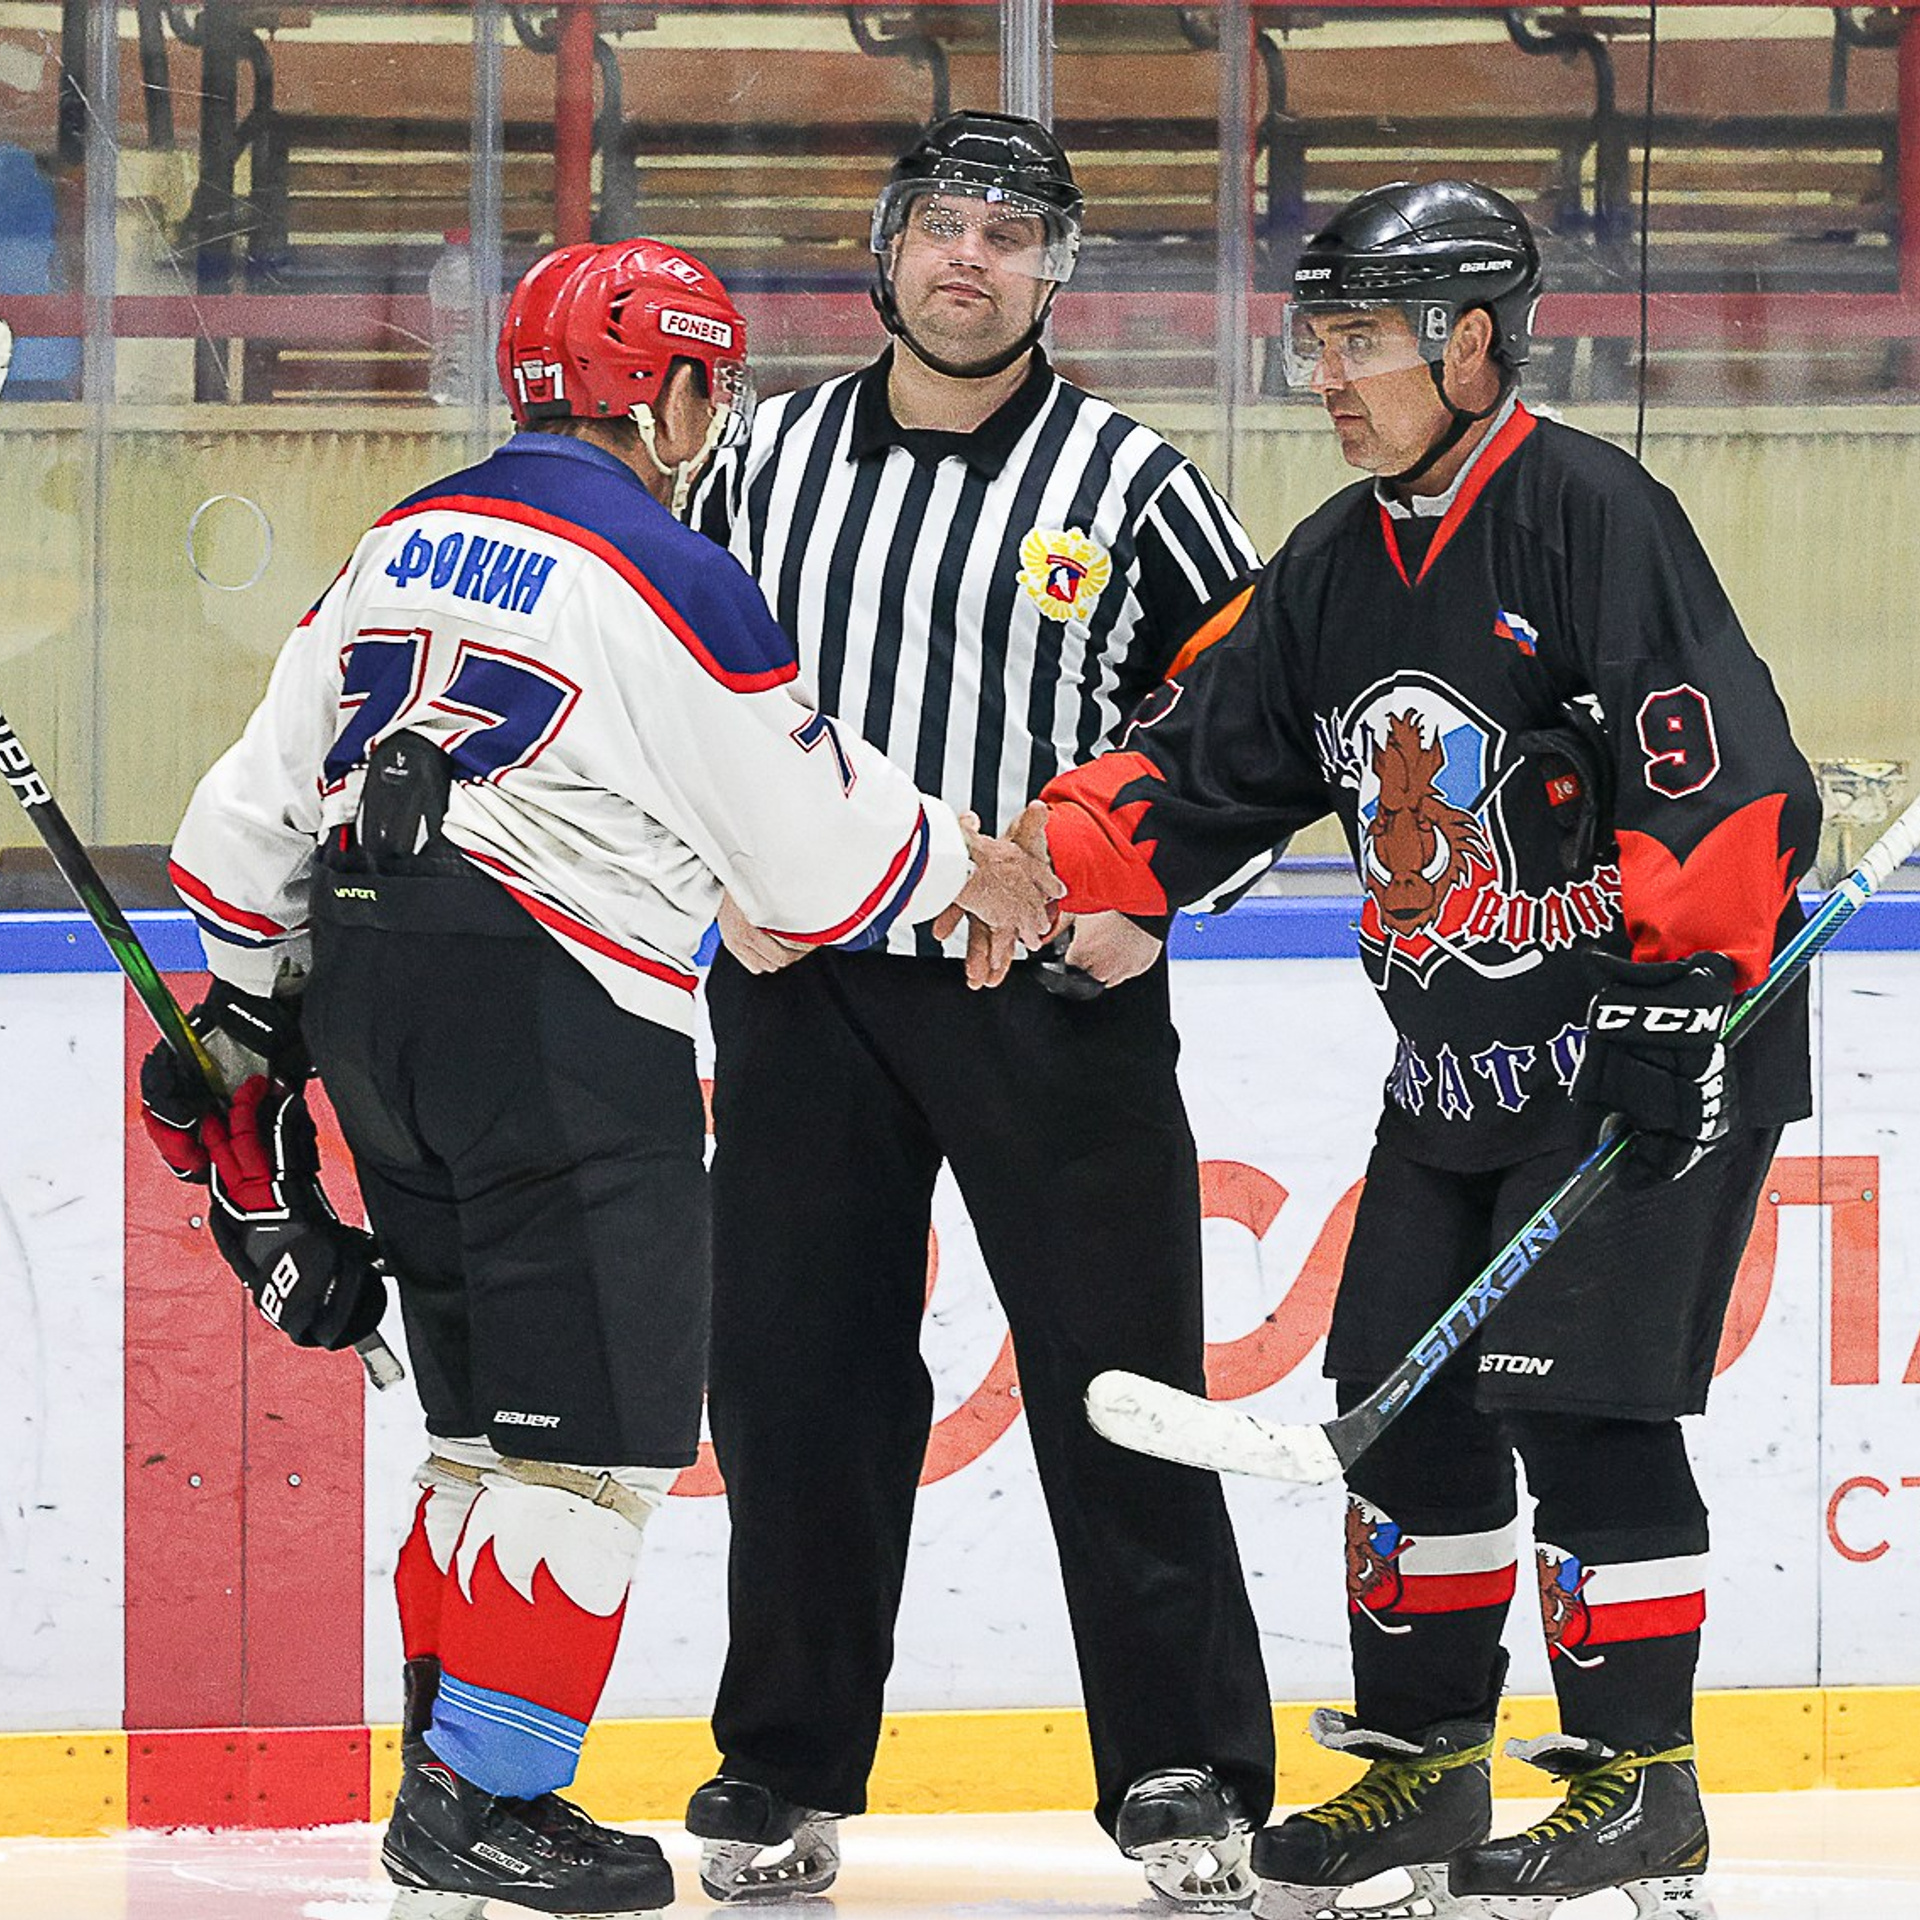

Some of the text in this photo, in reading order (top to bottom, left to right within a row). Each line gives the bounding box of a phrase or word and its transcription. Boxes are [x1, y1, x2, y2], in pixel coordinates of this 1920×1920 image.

[667, 314, 728, 344] FONBET
[384, 527, 558, 616] ФОКИН
[1635, 682, 1721, 799] 9
[1596, 1004, 1724, 1034] CCM
[1410, 1209, 1561, 1380] NEXUS
[1477, 1353, 1555, 1376] STON
[493, 1410, 561, 1429] BAUER
